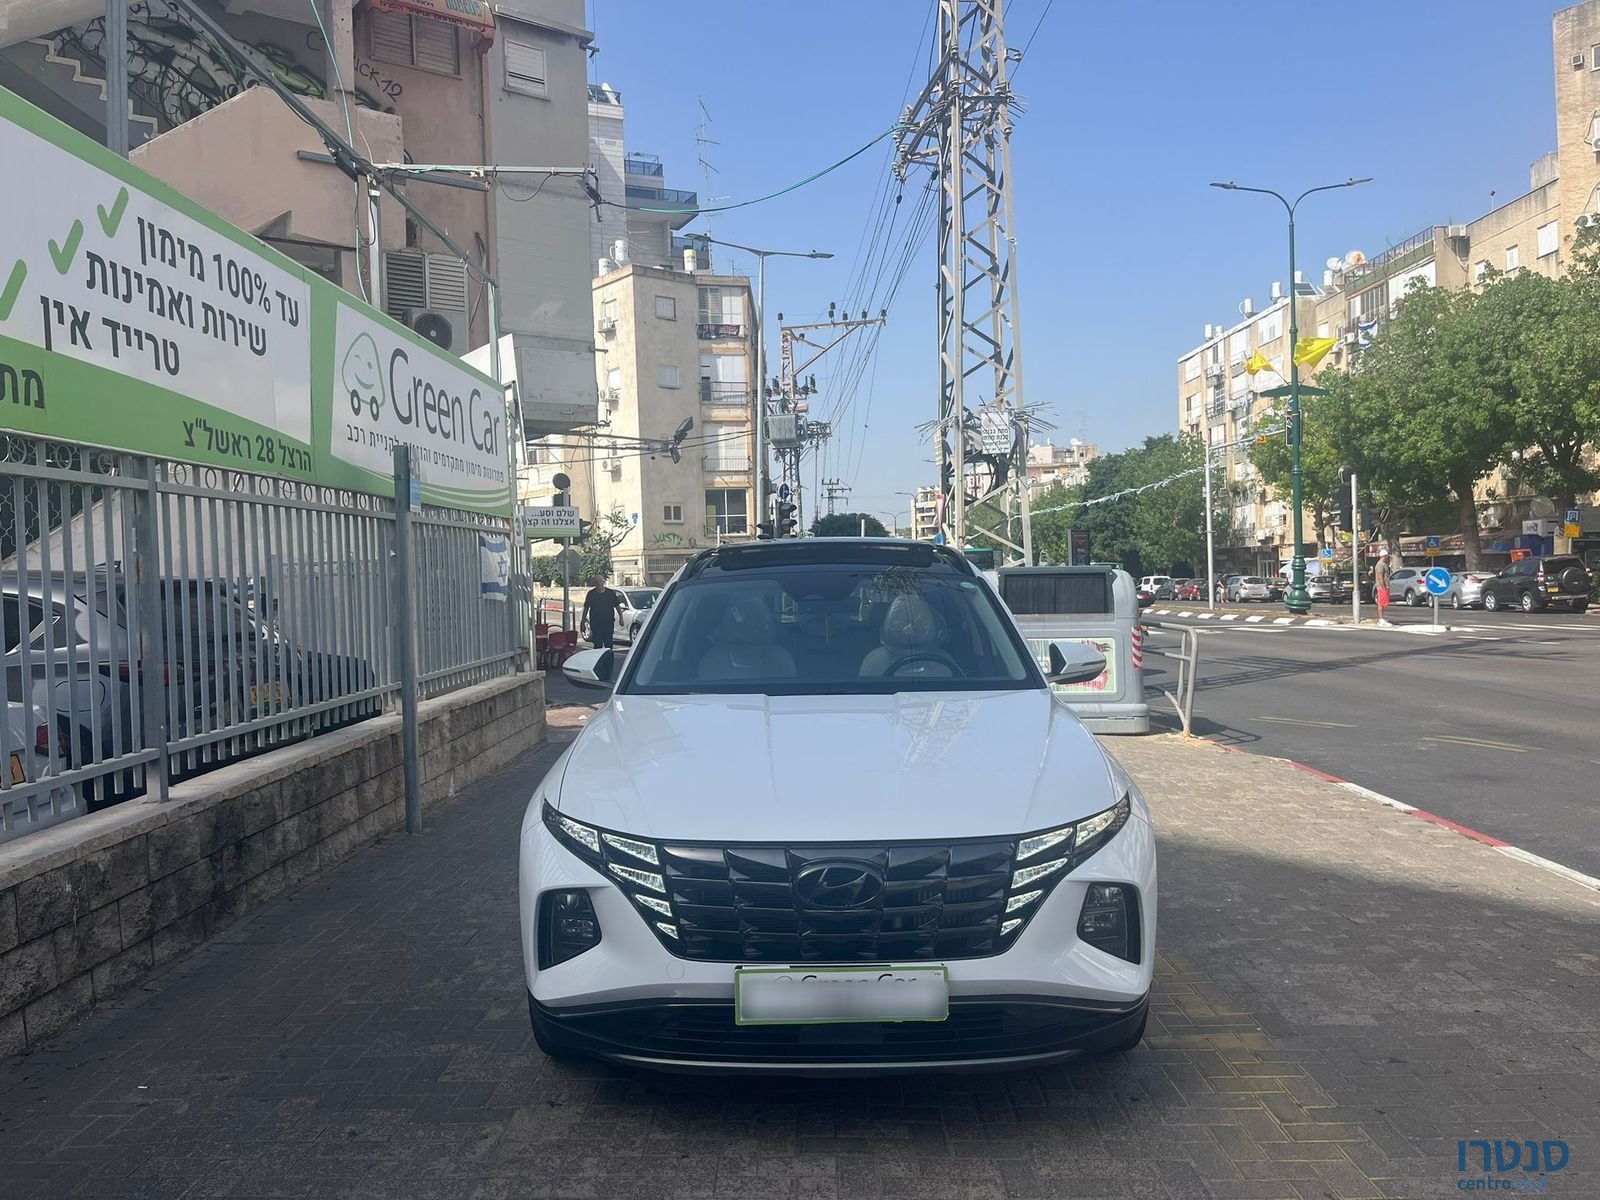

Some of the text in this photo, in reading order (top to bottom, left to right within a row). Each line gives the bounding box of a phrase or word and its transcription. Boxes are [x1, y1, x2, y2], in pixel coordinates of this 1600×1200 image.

[136, 216, 300, 328] עד 100% מימון
[86, 250, 267, 357] שירות ואמינות
[40, 295, 180, 376] טרייד אין
[390, 348, 500, 456] Green Car
[346, 424, 366, 445] רכב
[256, 436, 274, 464] 28
[279, 439, 312, 472] הרצל
[434, 450, 464, 473] מתקדמים
[552, 518, 575, 526] אצלנו
[556, 508, 575, 517] שלם
